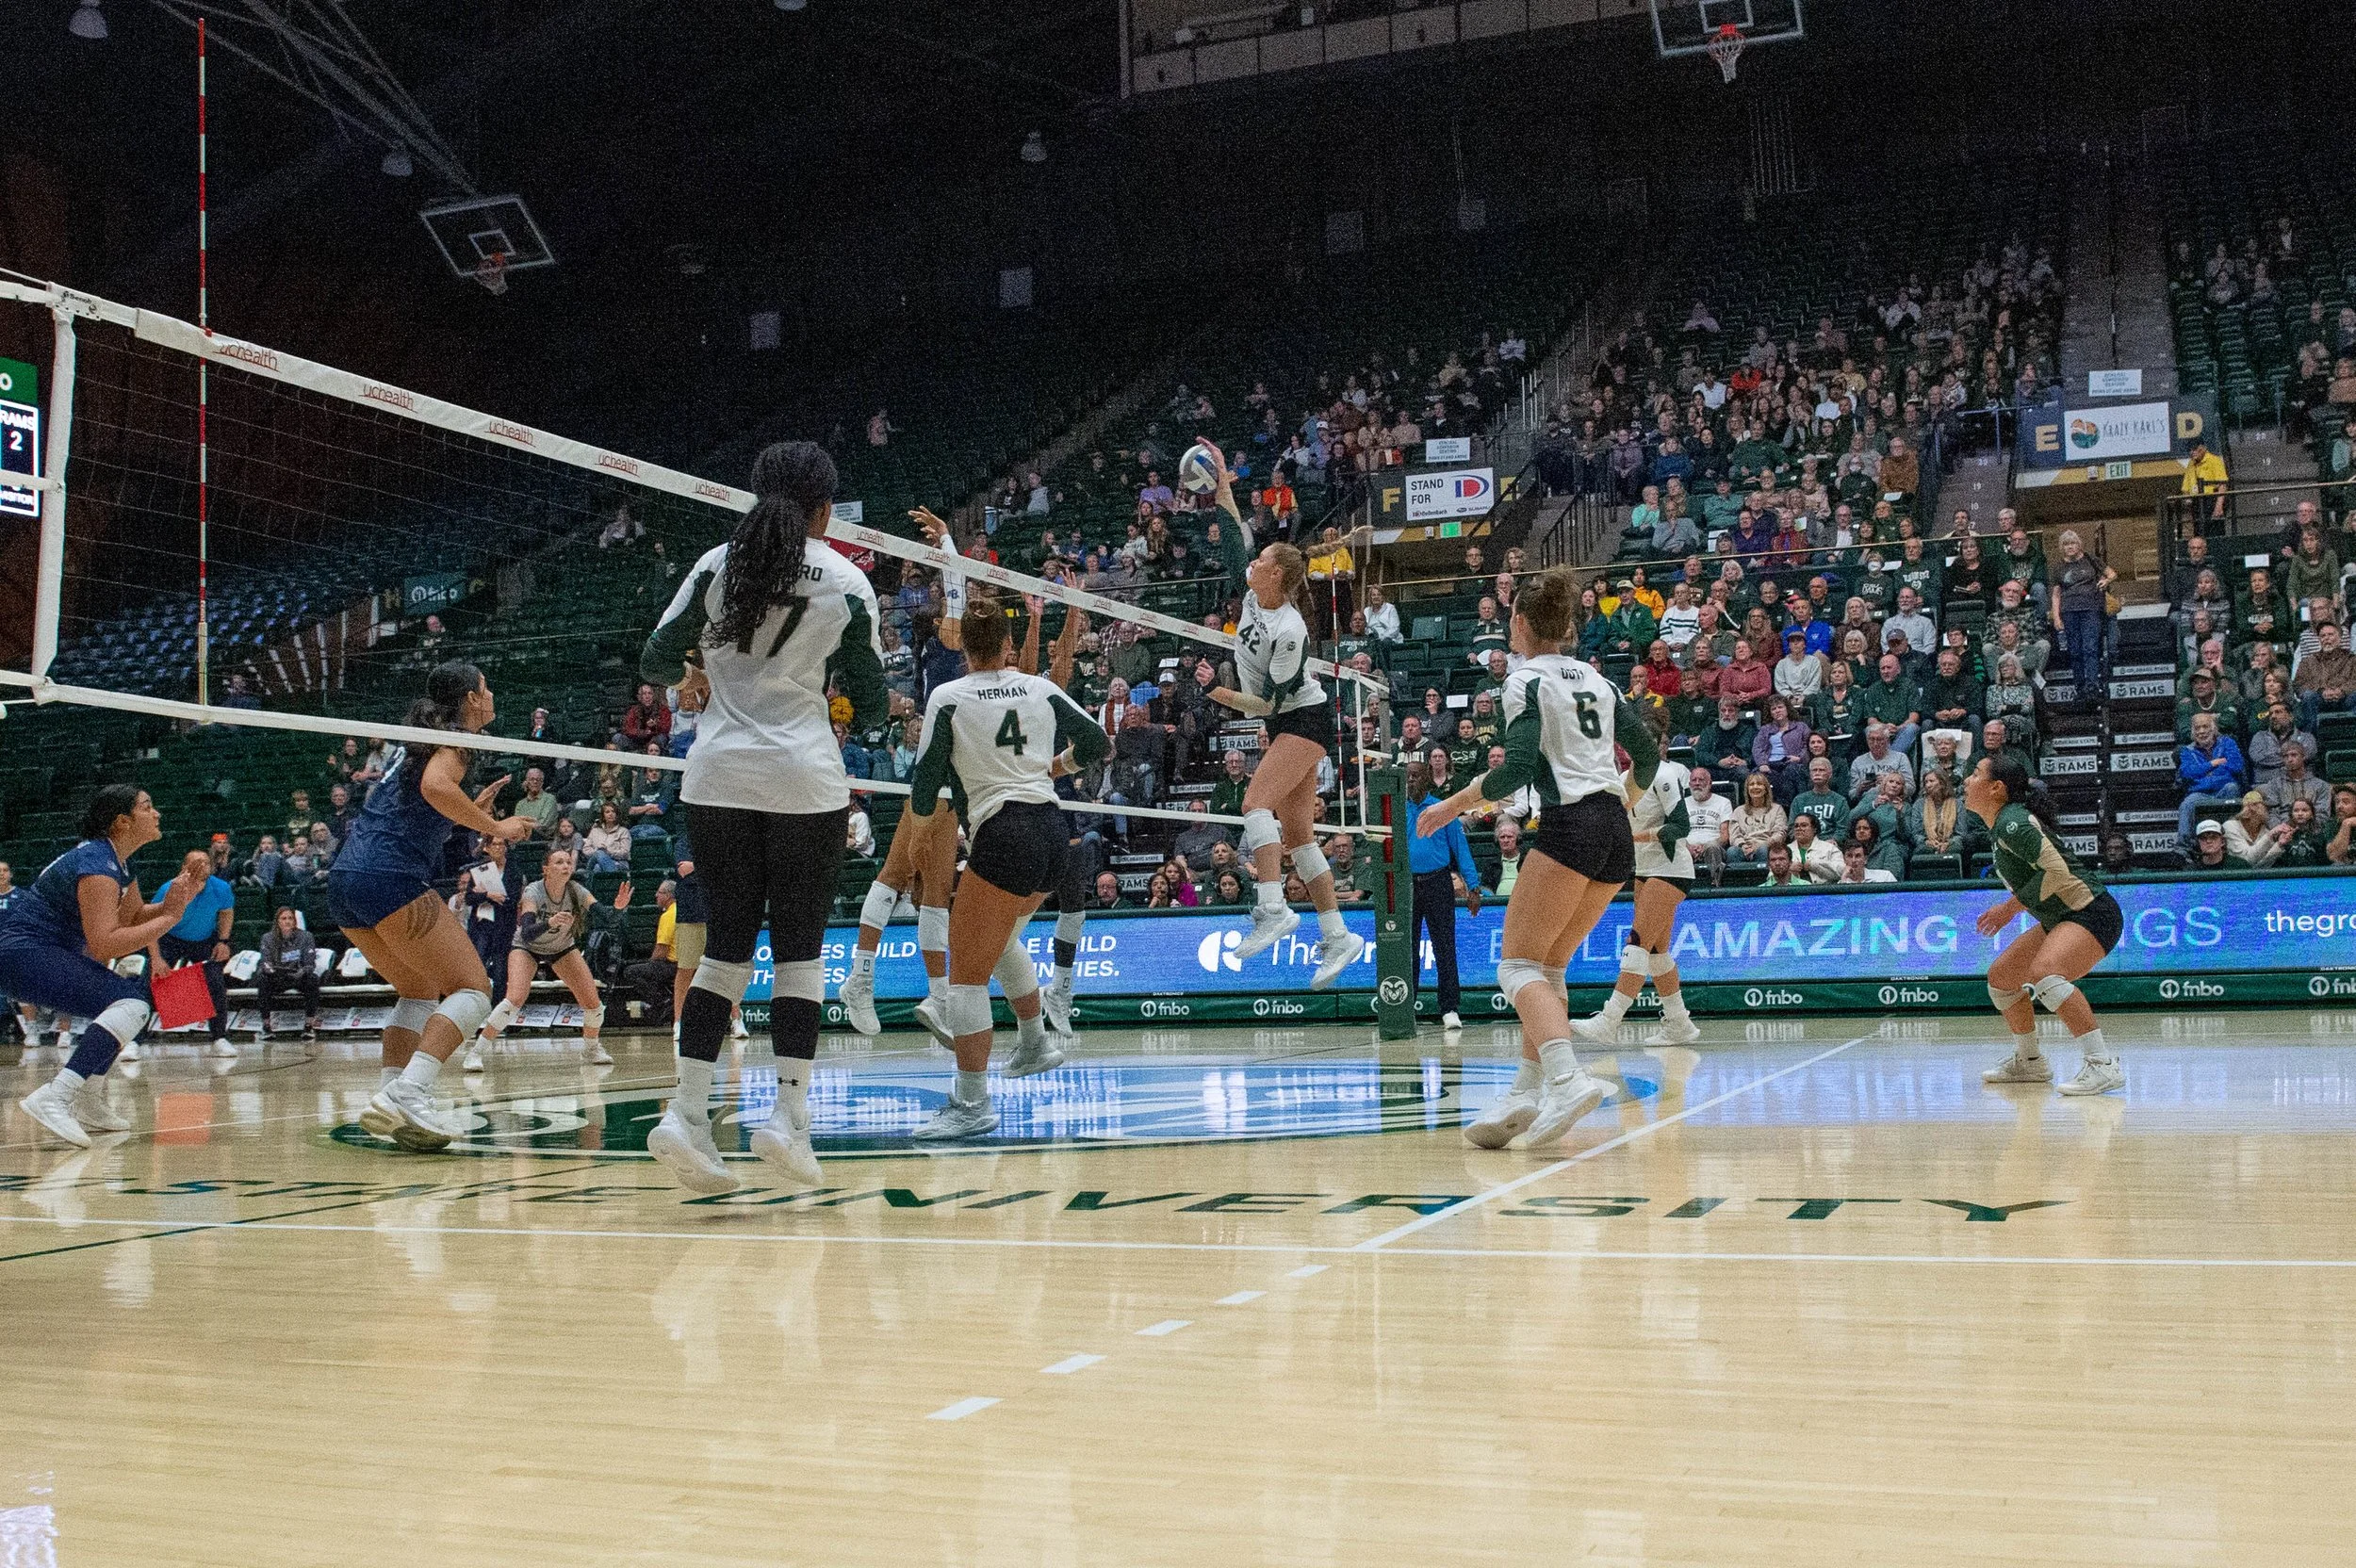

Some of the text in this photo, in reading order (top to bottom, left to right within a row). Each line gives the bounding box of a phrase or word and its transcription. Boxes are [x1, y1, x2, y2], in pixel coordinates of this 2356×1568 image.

[220, 341, 279, 371] uchealth
[362, 383, 416, 412] uchealth
[489, 420, 534, 446] uchealth
[2102, 416, 2166, 438] KRAZY KARL'S
[2177, 411, 2204, 439] D
[9, 430, 23, 451] 2
[2036, 424, 2060, 452] E
[597, 453, 639, 475] uchealth
[2109, 463, 2129, 478] EXIT
[694, 482, 730, 502] uchealth
[1411, 478, 1444, 491] STAND
[1382, 487, 1402, 513] F
[1411, 494, 1432, 505] FOR
[1238, 623, 1261, 656] 42
[1560, 666, 1585, 681] DOTY
[976, 686, 1028, 700] HERMAN
[2061, 692, 2077, 700] RA
[2129, 685, 2166, 696] RAMS
[1572, 691, 1603, 740] 6
[995, 709, 1028, 757] 4
[1229, 739, 1258, 749] RAMS
[2057, 760, 2096, 772] RAMS
[2132, 758, 2170, 768] RAMS
[1804, 803, 1835, 819] CSU
[2066, 841, 2097, 853] AMS
[2135, 838, 2175, 850] RAMS
[1120, 878, 1148, 889] RAMS
[1047, 936, 1117, 953] ILD
[1670, 914, 1957, 960] AMAZING
[2182, 980, 2225, 997] fnbo
[2331, 976, 2356, 994] fnb
[1636, 991, 1664, 1007] fnb
[1765, 988, 1804, 1004] fnbo
[1900, 986, 1939, 1003] fnbo
[1158, 1001, 1190, 1017] fnbo
[1271, 999, 1304, 1015] fnbo
[120, 1179, 2073, 1223] STATE UNIVERSITY
